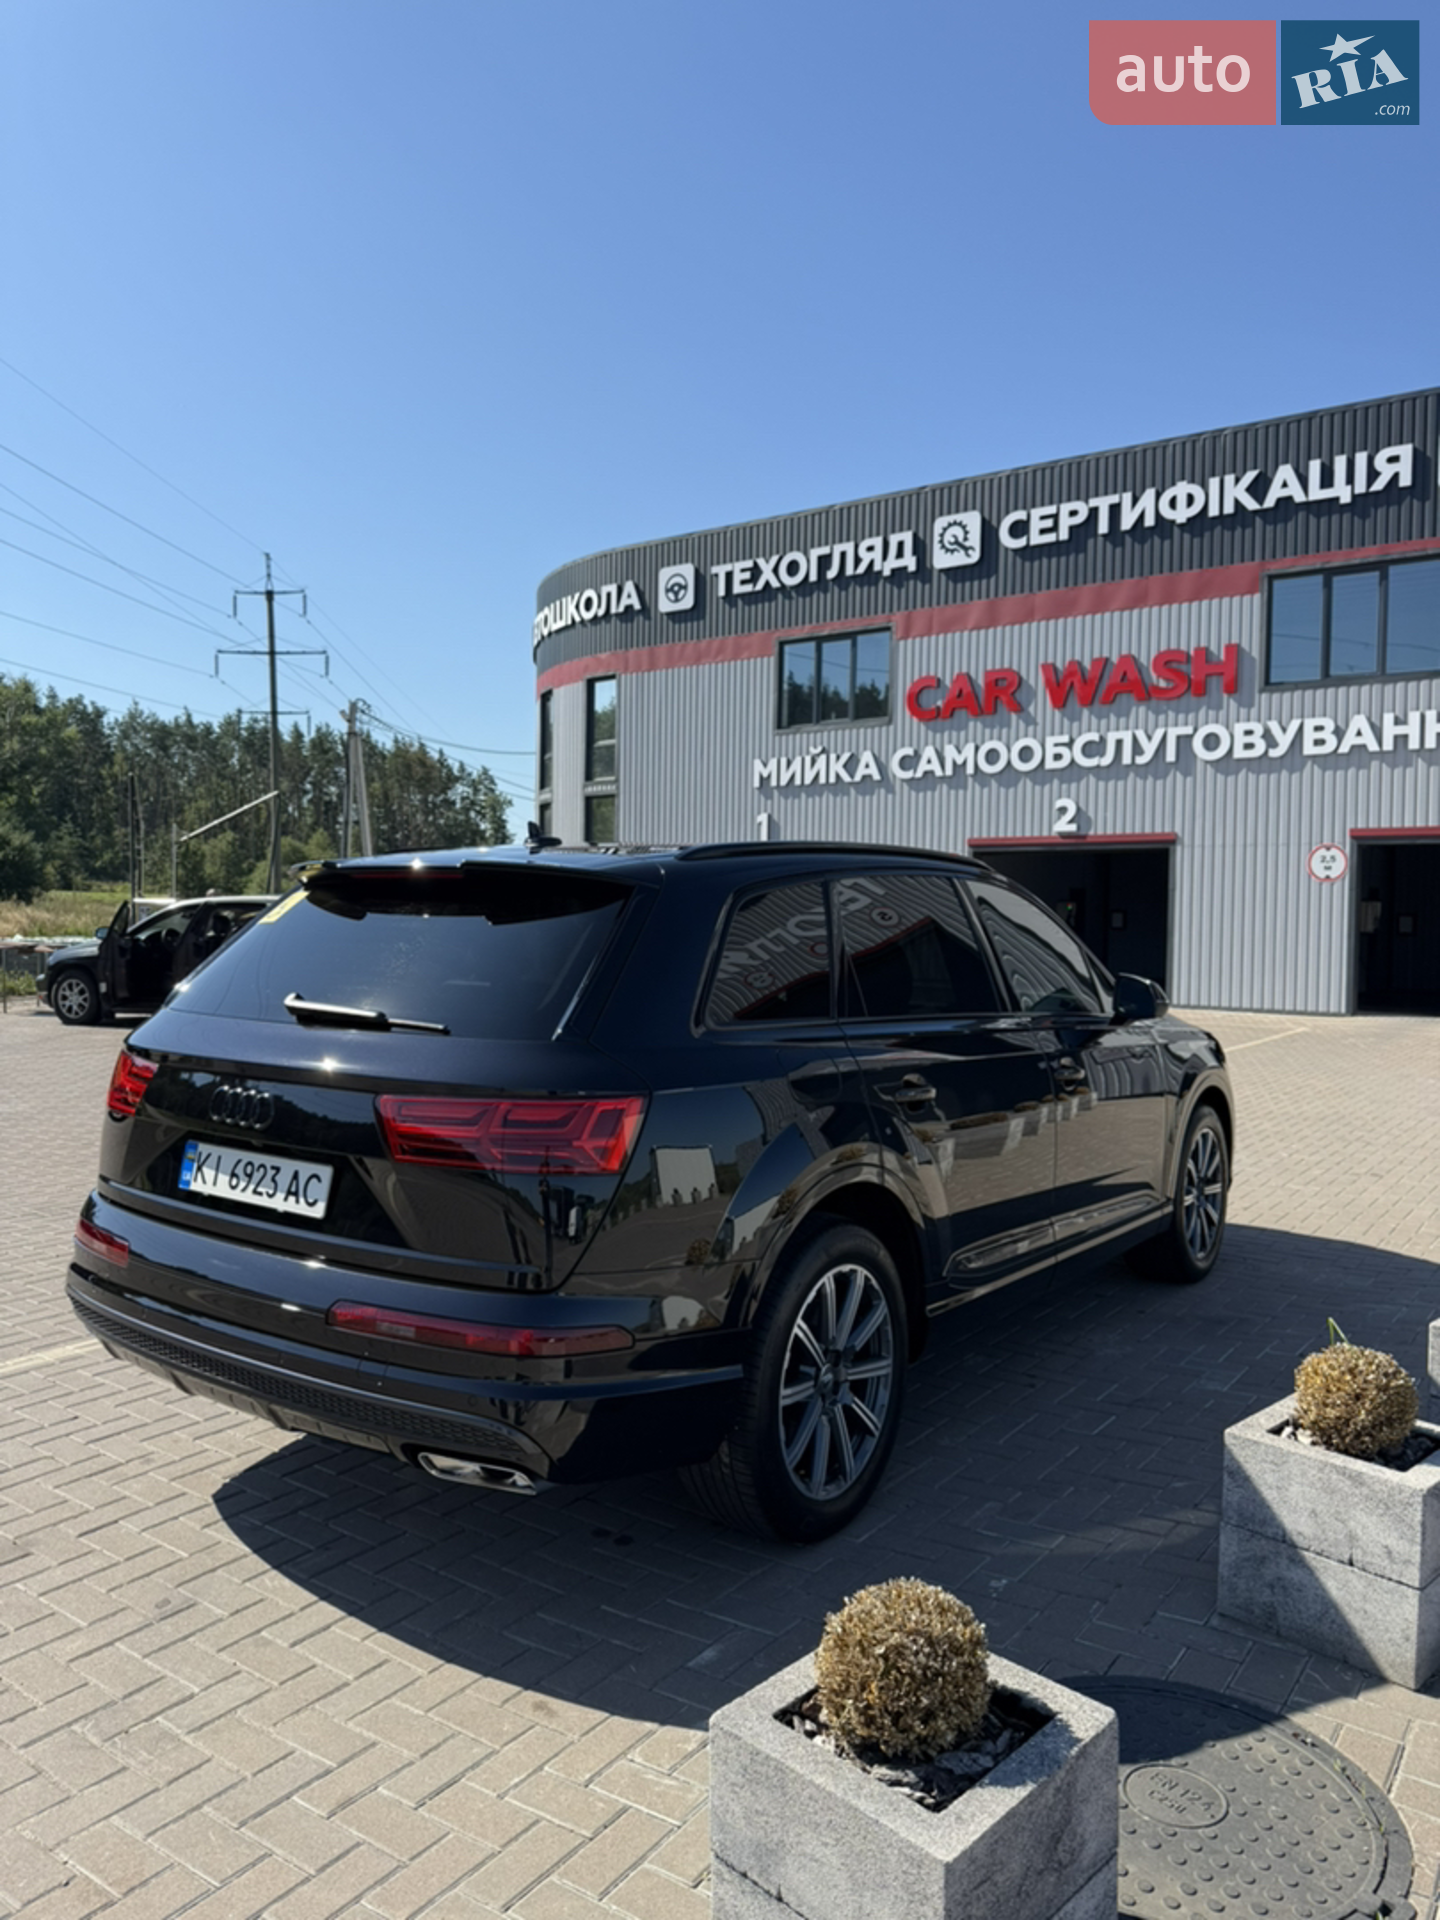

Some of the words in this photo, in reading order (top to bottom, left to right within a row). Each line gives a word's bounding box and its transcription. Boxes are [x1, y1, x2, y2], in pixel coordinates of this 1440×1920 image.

[711, 530, 917, 598] ТЕХОГЛЯД
[999, 443, 1413, 549] СЕРТИФІКАЦІЯ
[906, 668, 1023, 722] CAR
[1040, 643, 1239, 710] WASH
[753, 747, 881, 788] МИЙКА
[757, 812, 769, 841] 1
[1053, 798, 1078, 834] 2
[228, 1158, 281, 1199] 6923
[283, 1169, 322, 1208] AC
